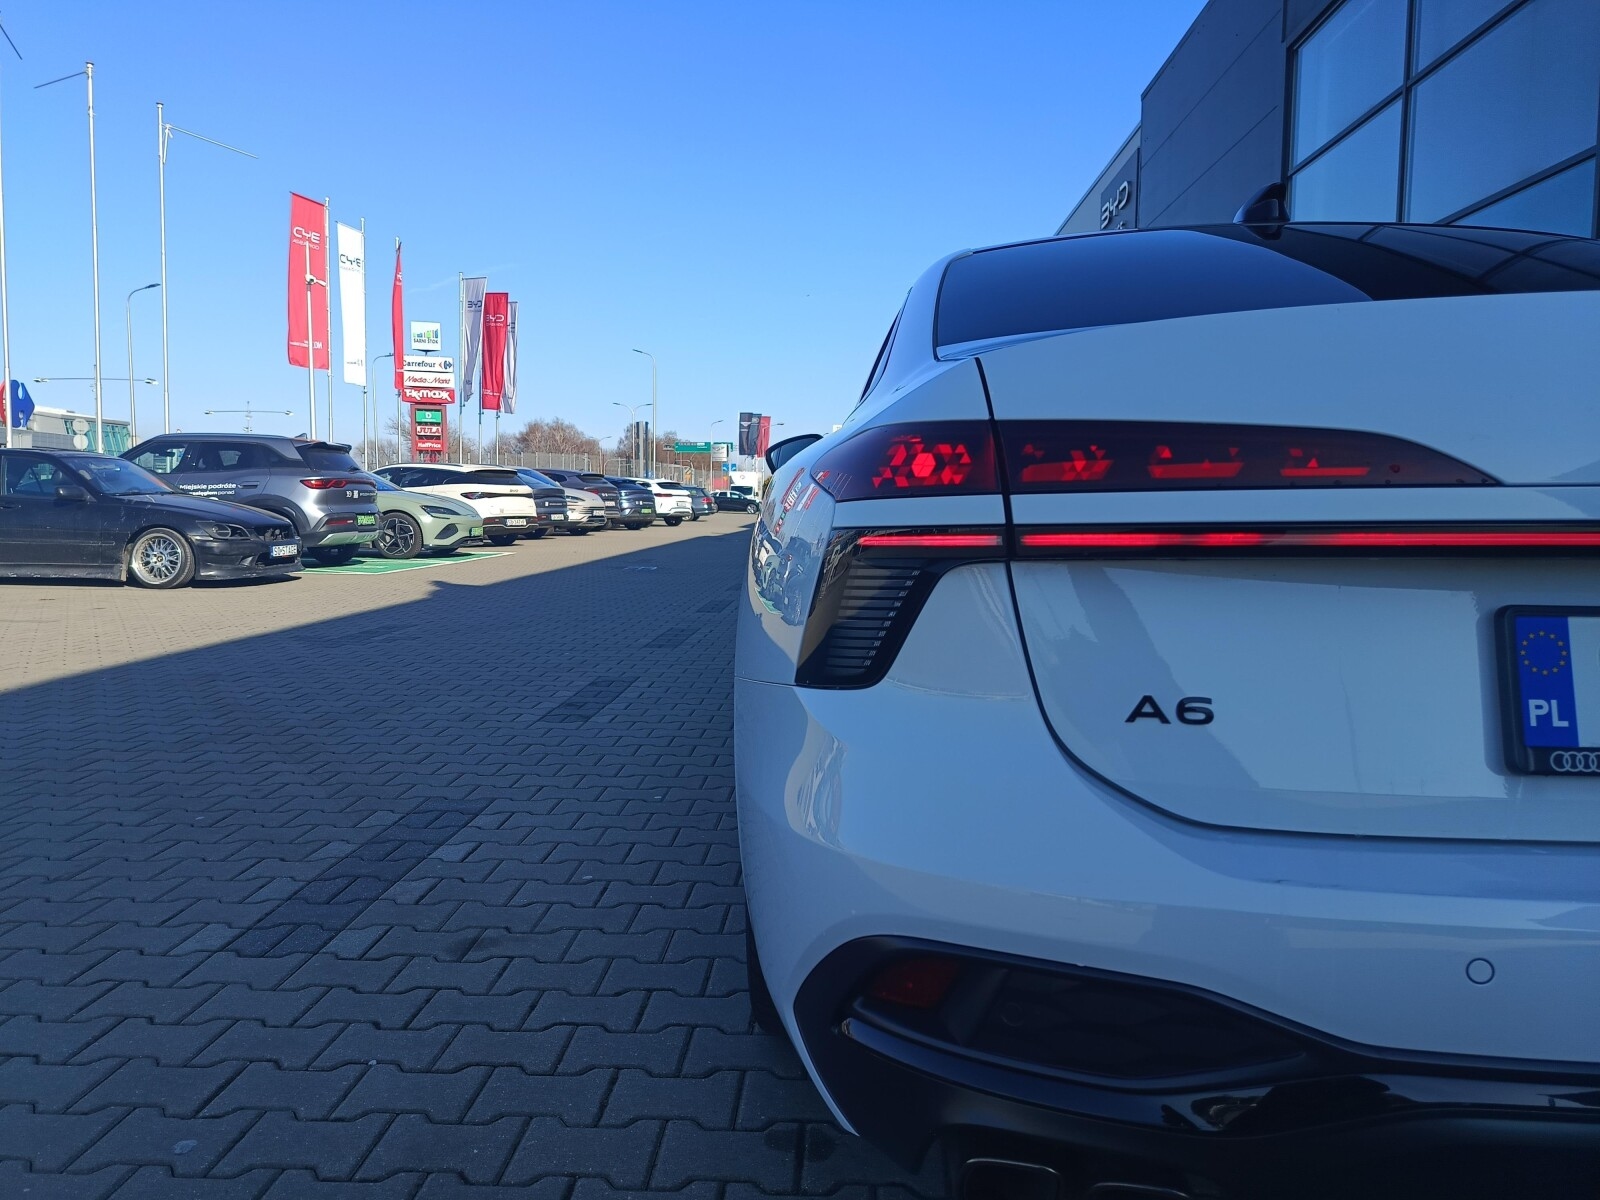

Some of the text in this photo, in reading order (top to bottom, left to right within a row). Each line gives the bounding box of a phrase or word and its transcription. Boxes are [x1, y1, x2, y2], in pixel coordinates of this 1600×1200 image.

[1101, 181, 1129, 230] BYD
[403, 360, 436, 368] Carrefour
[417, 426, 441, 435] JULA
[208, 482, 237, 490] podróże
[1124, 694, 1215, 726] A6
[1528, 699, 1570, 728] PL
